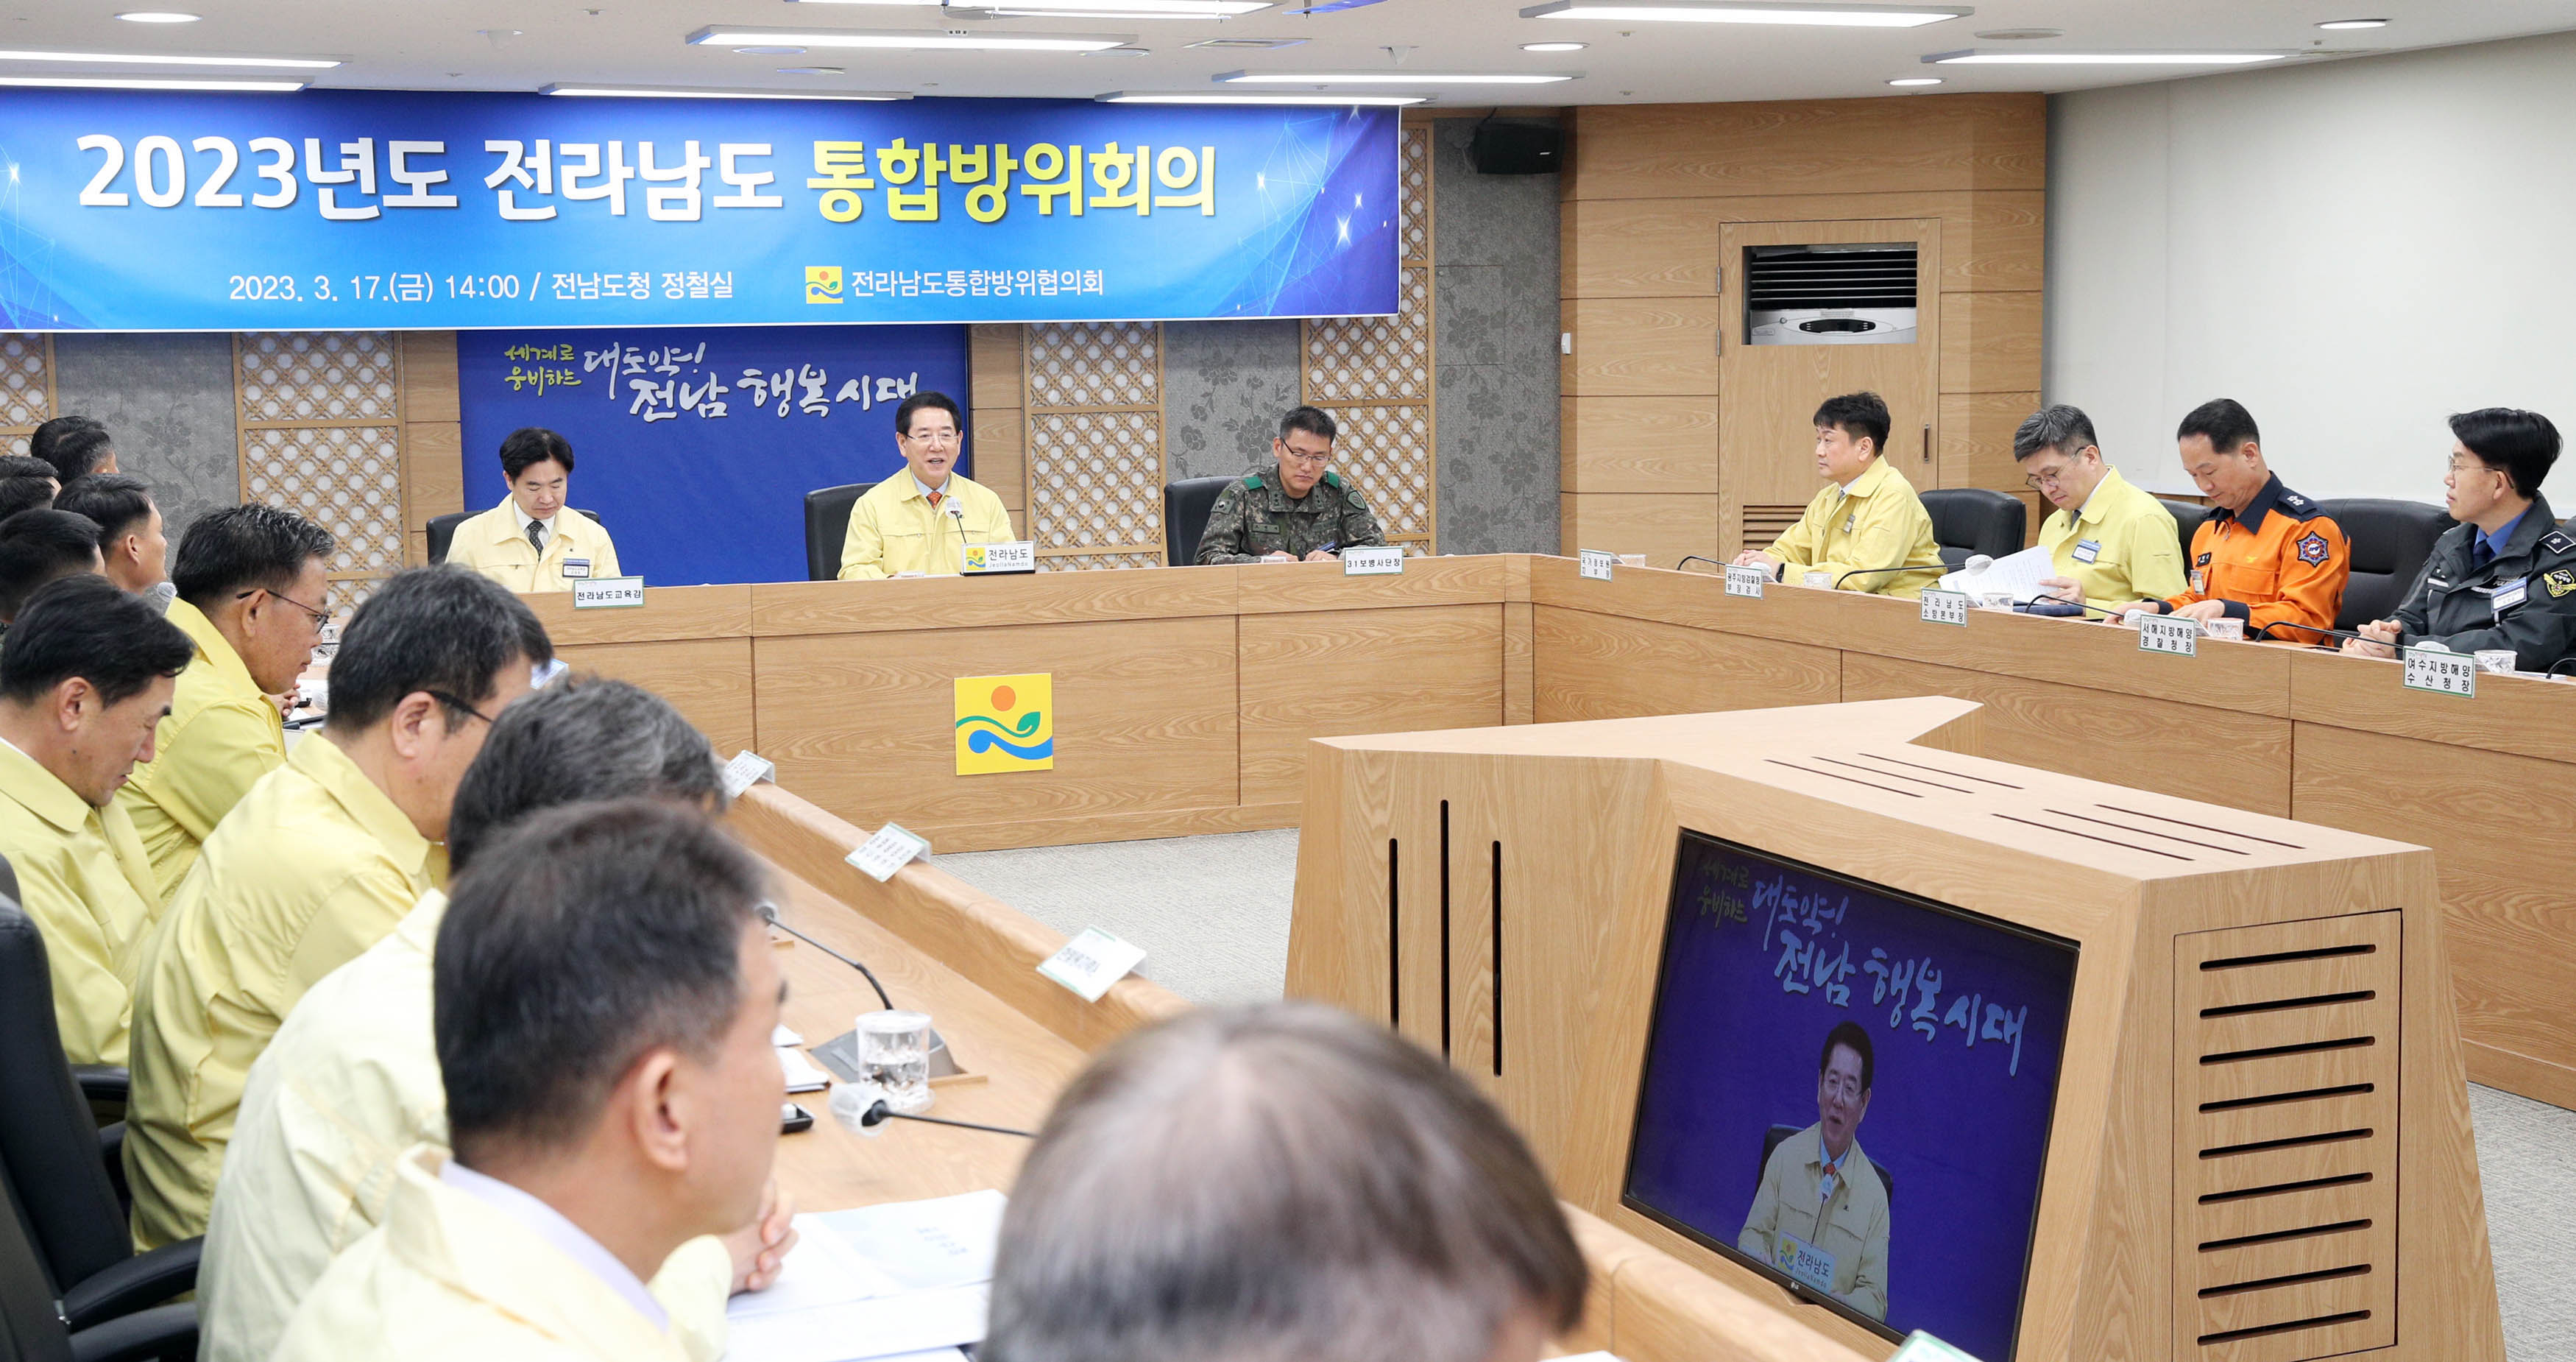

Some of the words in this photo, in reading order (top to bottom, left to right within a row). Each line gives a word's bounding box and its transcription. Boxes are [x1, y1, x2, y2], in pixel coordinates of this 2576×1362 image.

[76, 134, 458, 219] 2023년도
[484, 139, 783, 221] 전라남도
[807, 137, 1215, 222] 통합방위회의
[230, 275, 303, 303] 2023.
[315, 275, 338, 302] 3.
[447, 273, 520, 299] 14:00
[552, 272, 651, 300] 전남도청
[661, 271, 733, 298] 정철실
[852, 269, 1103, 297] 전라남도통합방위협의회
[504, 344, 575, 361] 세계로
[504, 366, 582, 396] 웅비하는
[584, 342, 707, 401] 대도약!
[629, 371, 729, 423] 전남
[737, 364, 831, 417] 행복
[988, 548, 1029, 561] 전라남도
[1348, 559, 1400, 568] 31보병사단장
[576, 590, 642, 601] 전라남도교육감
[1923, 609, 1964, 623] 소방본부장
[2142, 623, 2193, 640] 서해지방해양
[2407, 657, 2471, 677] 여수지방해양
[1752, 875, 1849, 952] 대도약!
[1774, 929, 1856, 1008] 전남
[1863, 947, 1942, 1042] 행복
[1797, 1249, 1830, 1278] 전라남도
